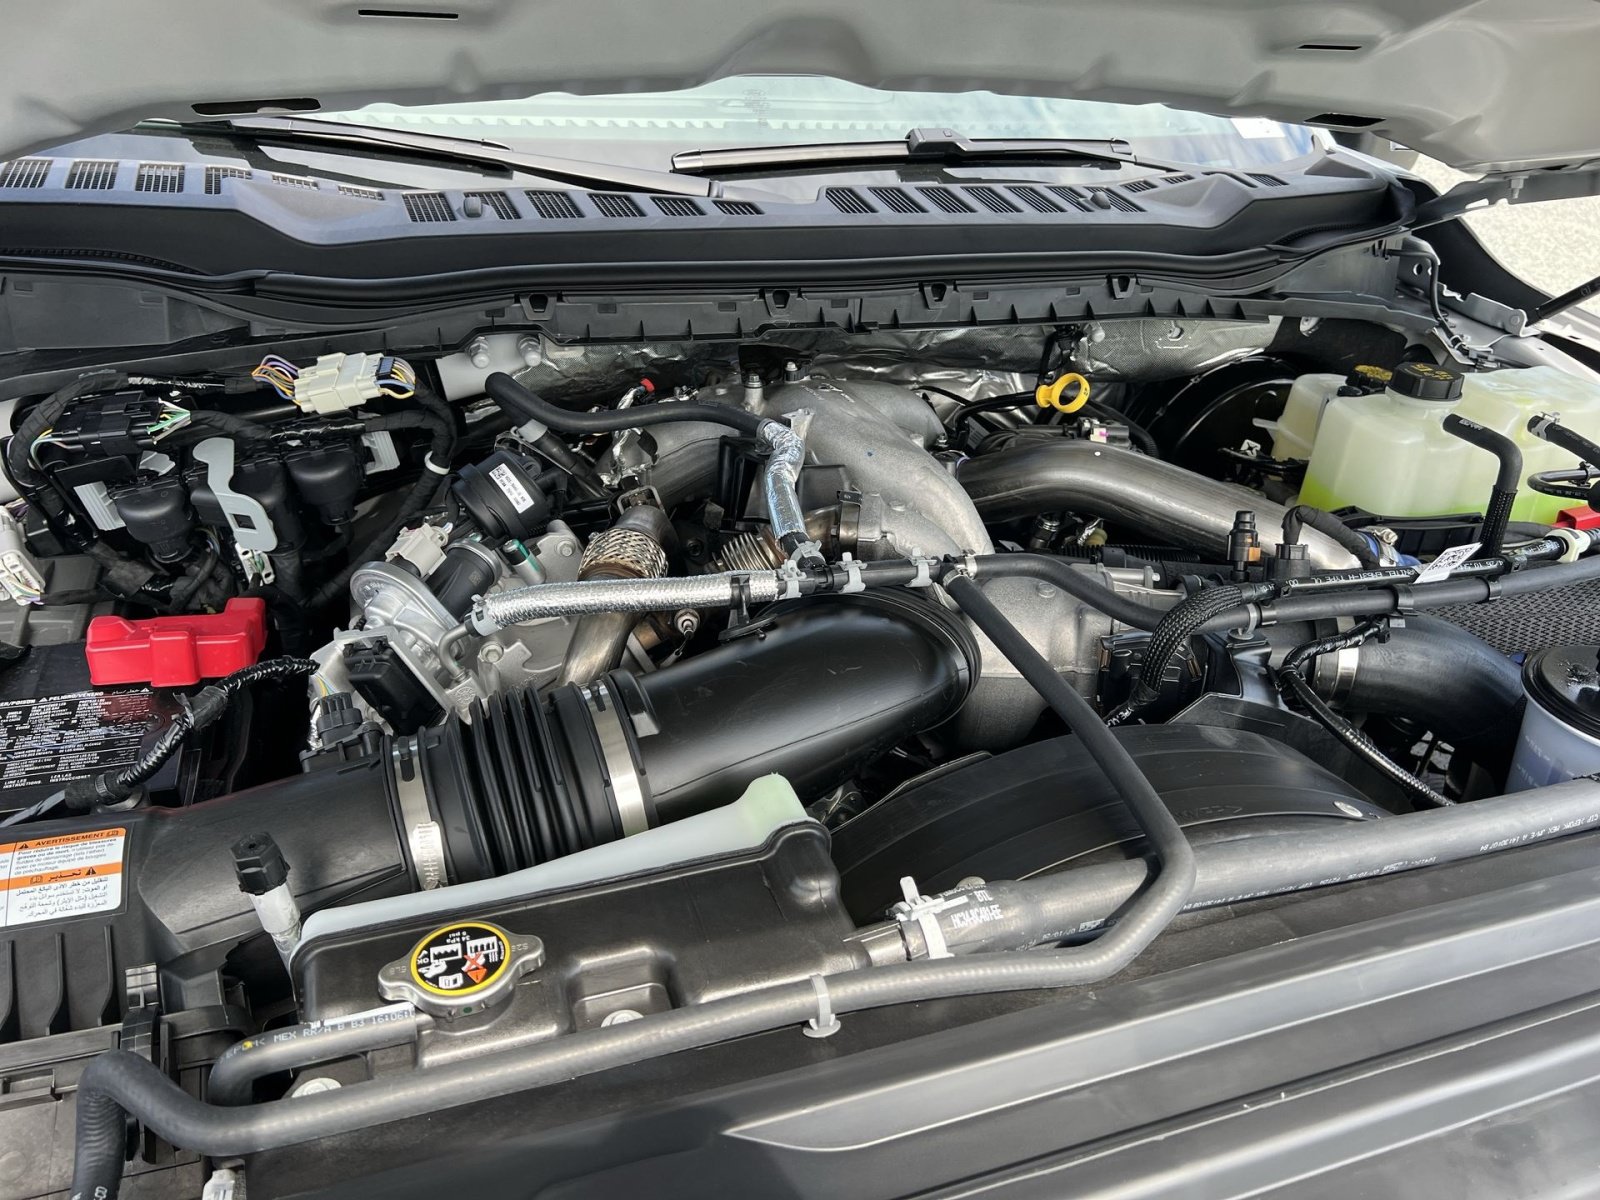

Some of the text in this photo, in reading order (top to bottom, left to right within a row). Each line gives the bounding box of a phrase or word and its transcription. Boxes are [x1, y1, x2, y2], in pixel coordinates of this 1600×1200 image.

[35, 832, 105, 847] AVERTISSEMENT
[446, 935, 471, 945] 34 kPa
[417, 957, 430, 966] OK
[273, 1029, 298, 1044] MEX
